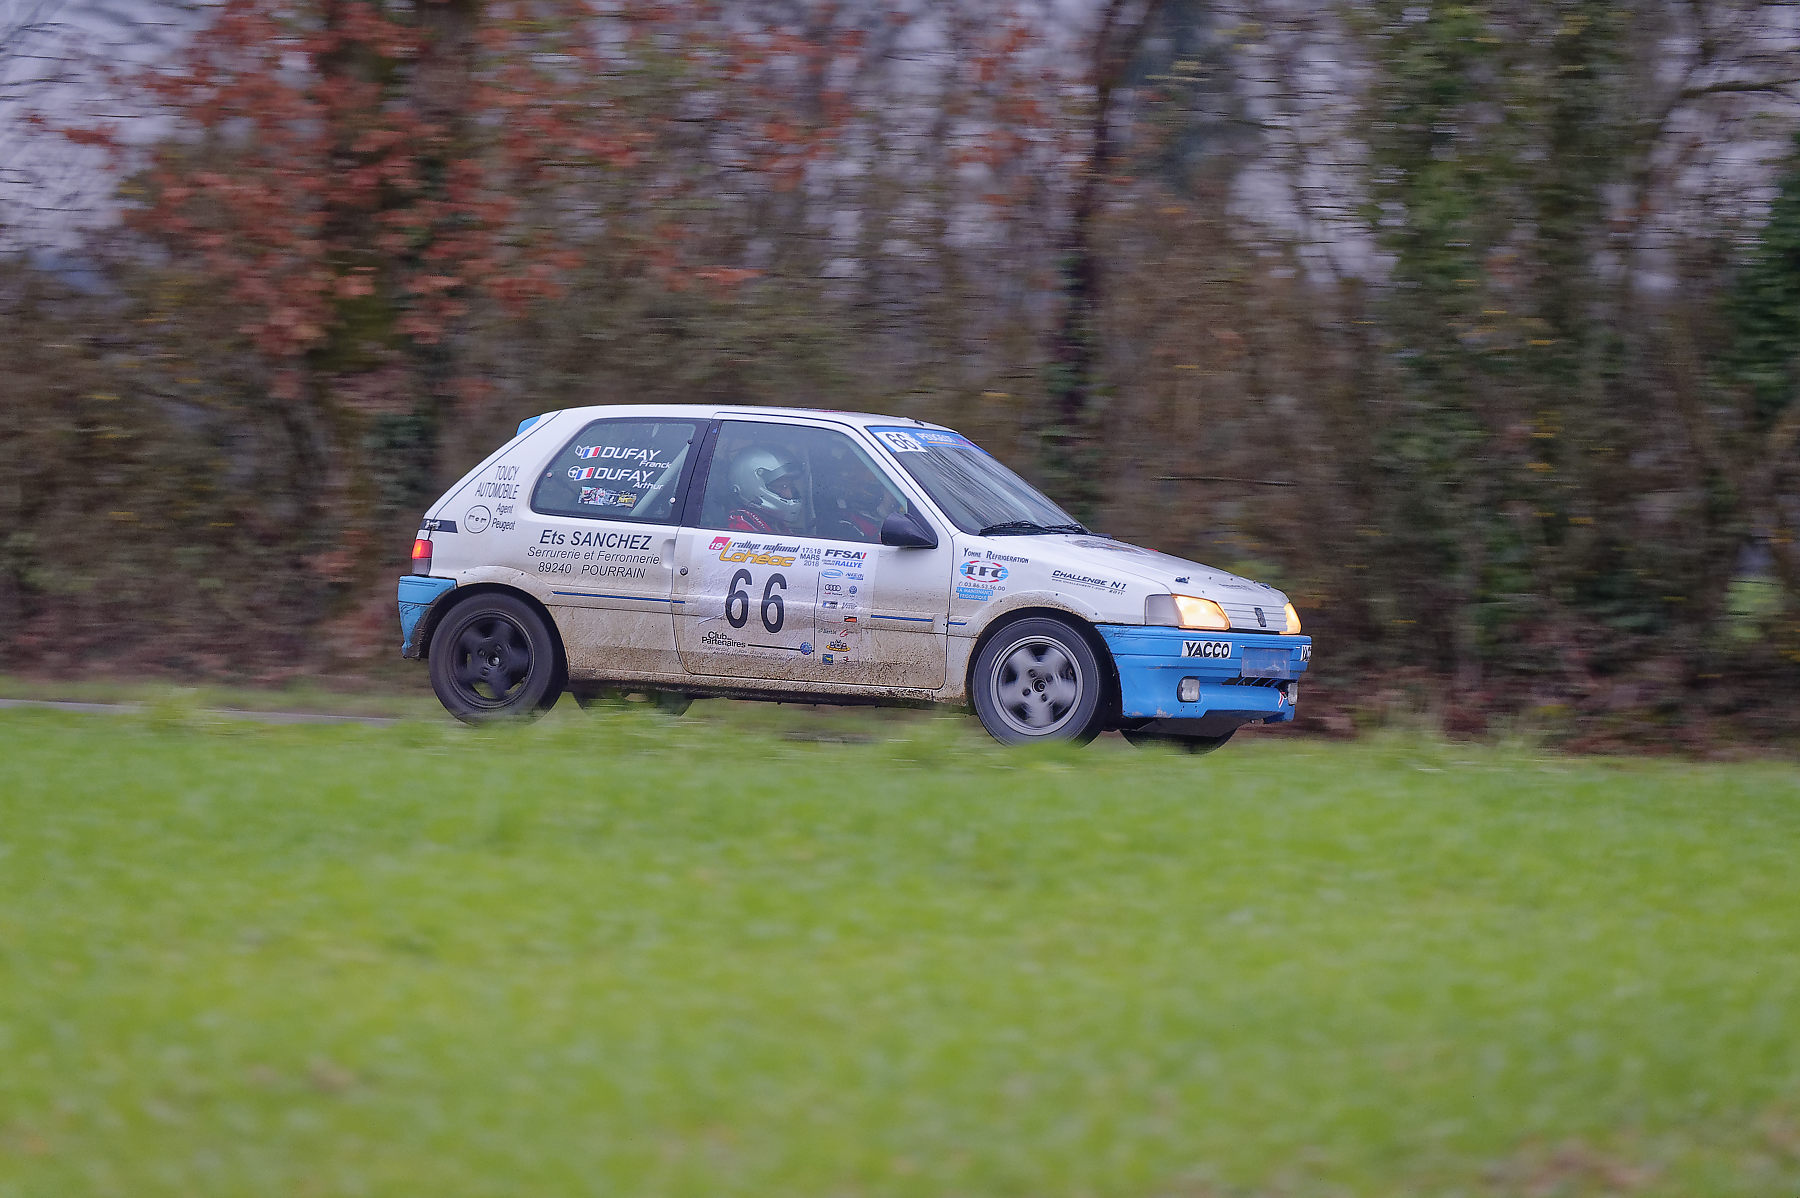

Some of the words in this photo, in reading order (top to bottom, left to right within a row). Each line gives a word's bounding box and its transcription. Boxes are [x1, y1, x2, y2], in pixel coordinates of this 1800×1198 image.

[601, 446, 661, 461] DUFAY
[639, 460, 672, 469] Franck
[495, 465, 520, 481] TOUCY
[594, 467, 654, 482] DUFAY
[474, 481, 520, 500] AUTOMOBILE
[632, 482, 664, 490] Arthur
[496, 503, 514, 516] Agent
[491, 517, 516, 532] Peugeot
[540, 529, 566, 545] Ets
[570, 531, 653, 551] SANCHEZ
[731, 541, 761, 552] rallye
[762, 543, 801, 553] national
[527, 546, 581, 560] Serrurerie
[583, 550, 596, 560] et
[597, 550, 660, 565] Ferronnerie
[719, 541, 796, 567] Lohéac
[800, 553, 821, 561] MARS
[824, 549, 861, 559] FFSA
[538, 562, 572, 574] 89240
[581, 565, 646, 579] POURRAIN
[835, 560, 863, 569] RALLYE
[964, 564, 1005, 579] IFC
[1052, 569, 1108, 586] CHALLENGE
[725, 568, 788, 634] 66
[701, 636, 746, 648] Partenaires
[707, 631, 728, 640] Club
[1185, 642, 1230, 658] YACCO
